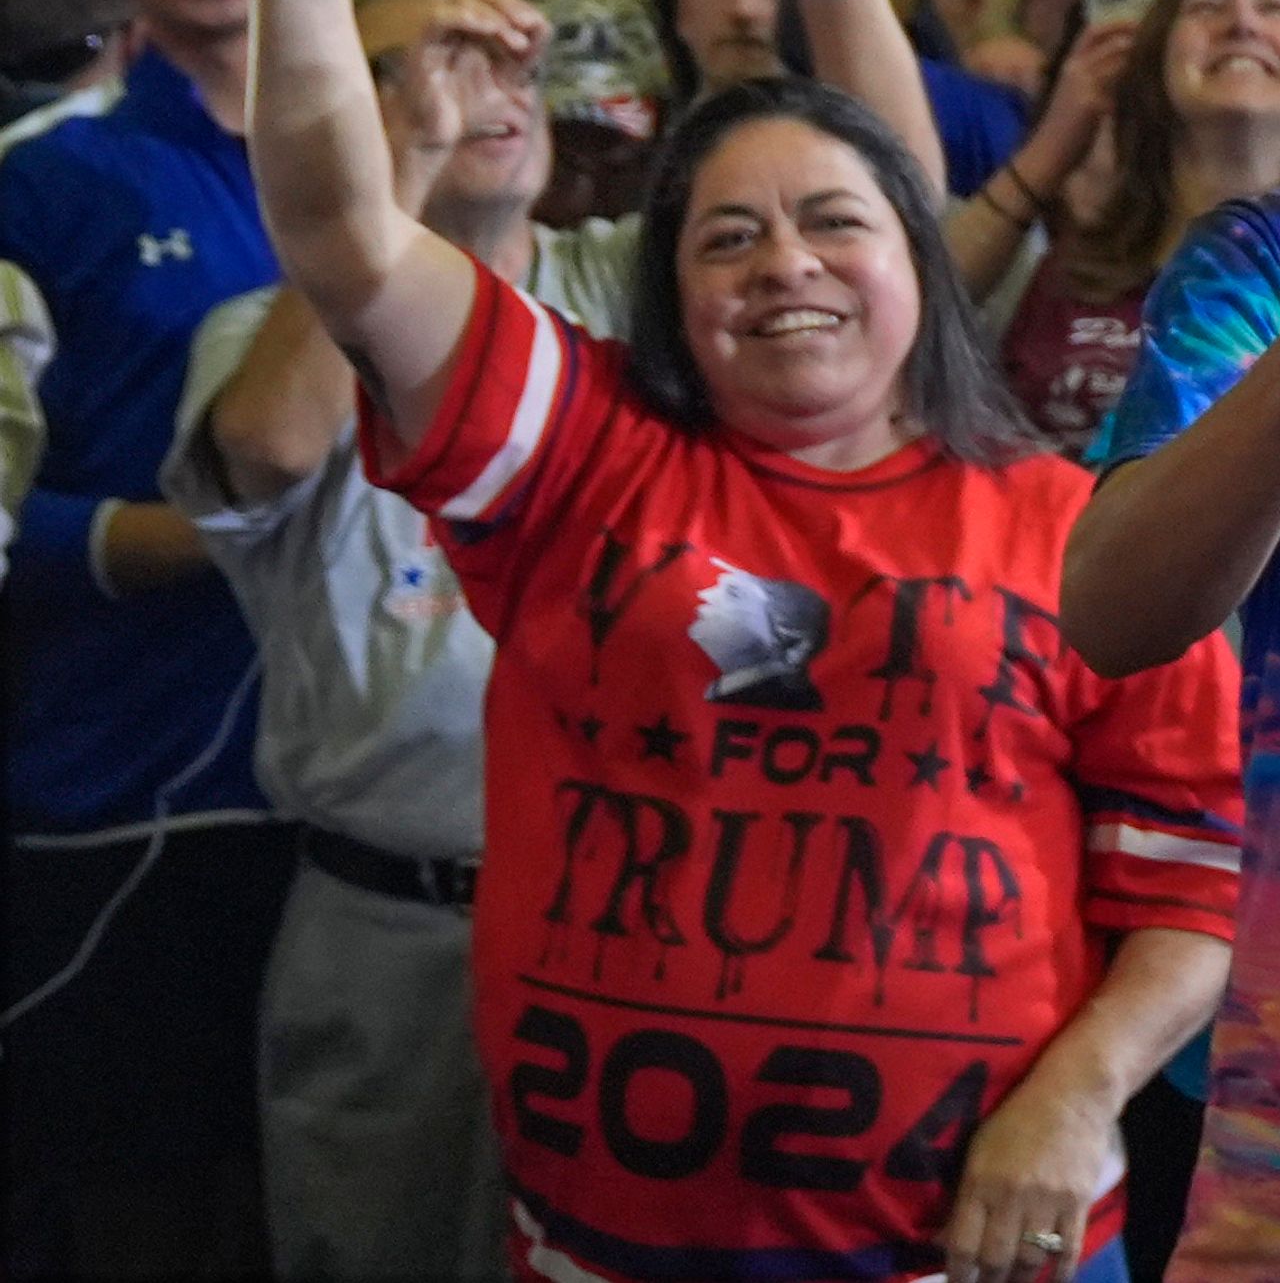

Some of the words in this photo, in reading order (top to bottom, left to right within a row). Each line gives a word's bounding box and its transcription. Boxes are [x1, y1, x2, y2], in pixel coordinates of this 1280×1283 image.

[580, 525, 1060, 717] VTE
[709, 718, 882, 787] FOR
[543, 777, 1025, 997] TRUMP
[508, 1003, 989, 1191] 2024
